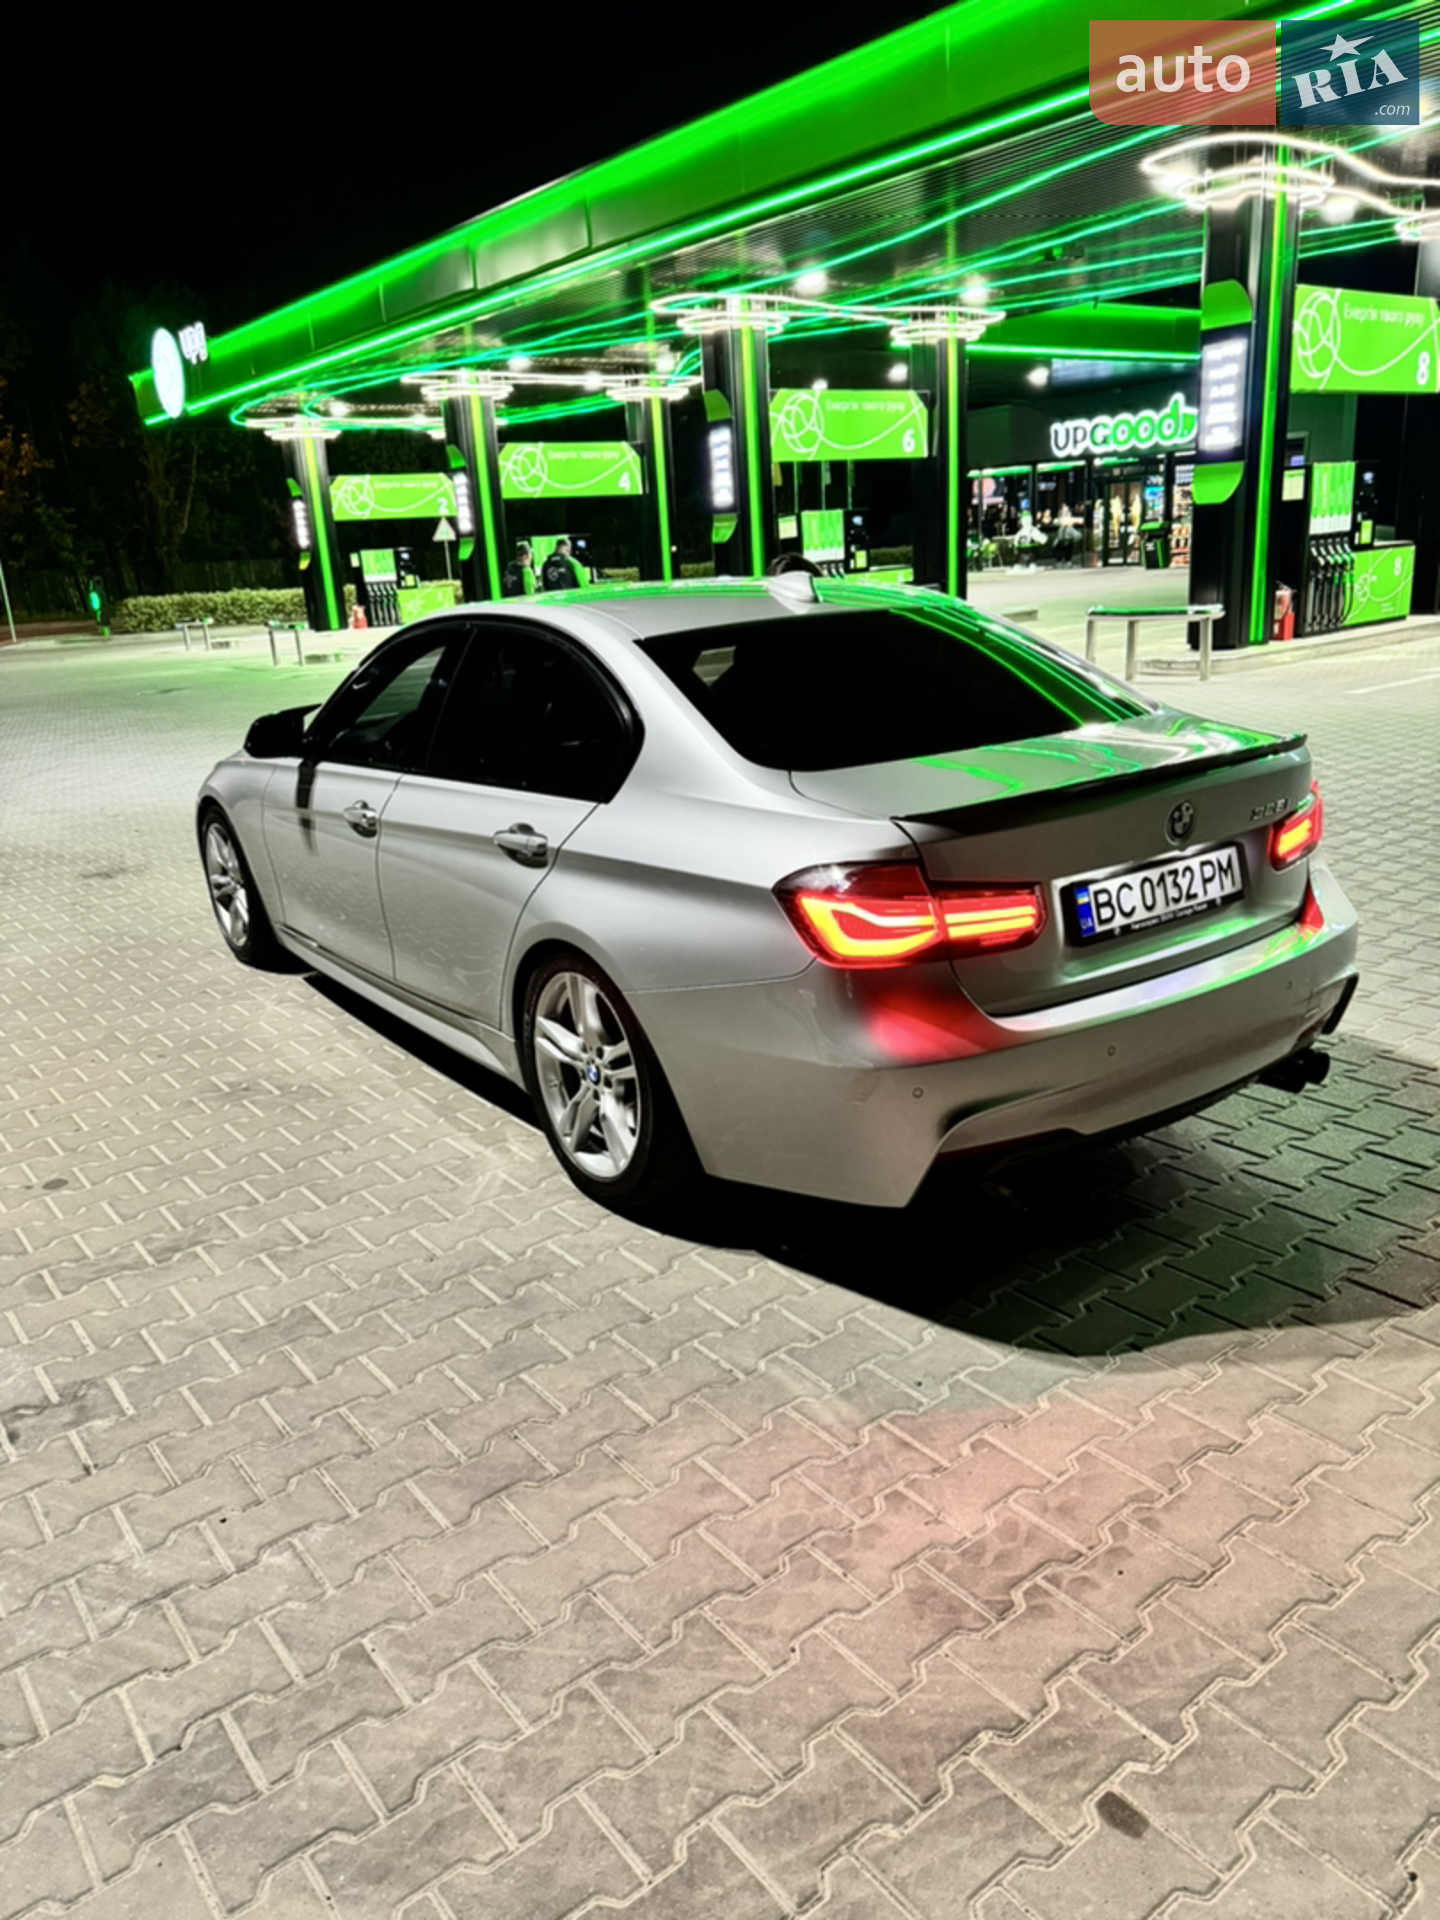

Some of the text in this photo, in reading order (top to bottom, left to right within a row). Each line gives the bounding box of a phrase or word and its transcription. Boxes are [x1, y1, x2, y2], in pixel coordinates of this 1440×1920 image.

[1416, 351, 1431, 386] 8
[902, 428, 915, 453] 6
[618, 471, 631, 492] 4
[437, 497, 449, 516] 2
[1093, 853, 1236, 926] BC 0132 PM
